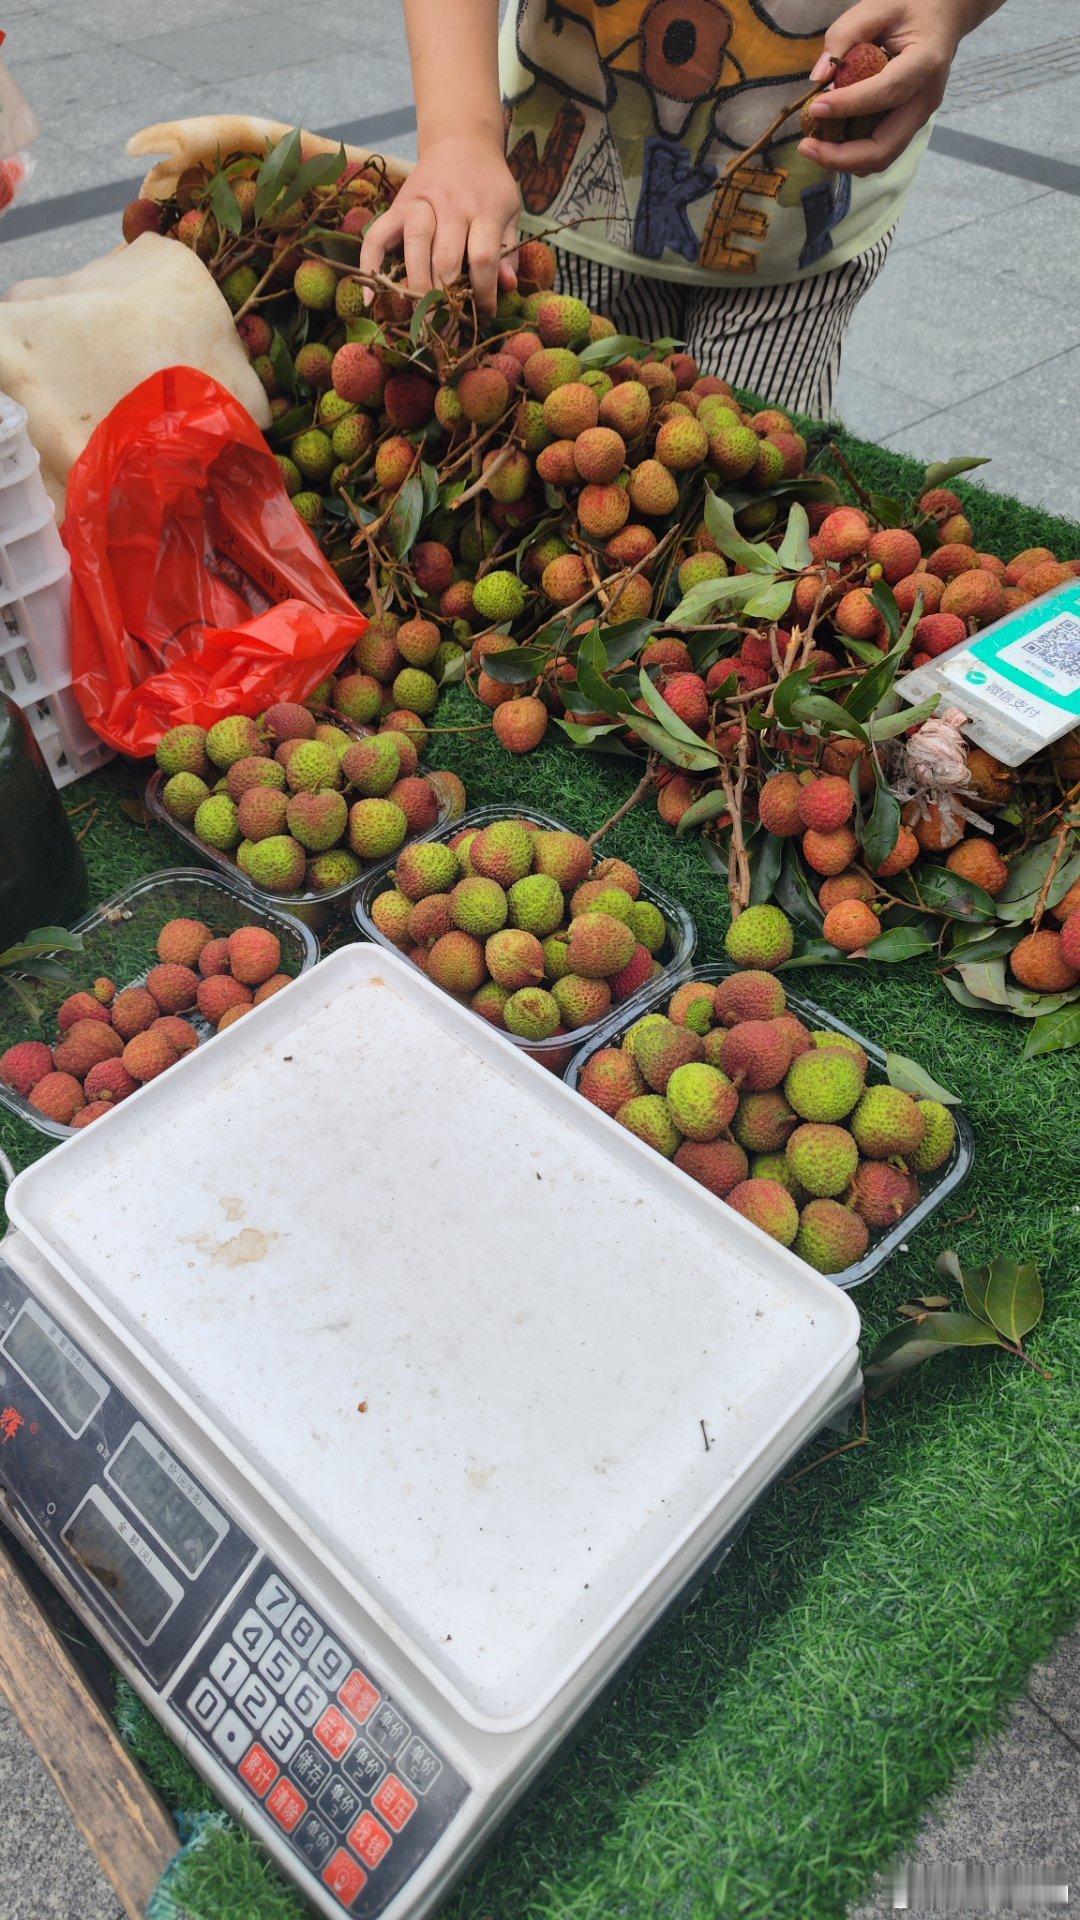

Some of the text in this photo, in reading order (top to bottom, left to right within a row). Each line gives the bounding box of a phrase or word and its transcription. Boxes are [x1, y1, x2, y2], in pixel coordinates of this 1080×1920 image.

[985, 683, 1041, 718] 微信支付
[120, 1522, 153, 1565] 金额(元)
[267, 1585, 289, 1611] 7
[243, 1627, 263, 1650] 4
[291, 1616, 315, 1647] 8
[221, 1657, 238, 1682] 1
[266, 1651, 293, 1682] 5
[317, 1648, 343, 1680] 9
[195, 1689, 218, 1720] 0
[243, 1685, 267, 1720] 2
[294, 1684, 320, 1716] 6
[269, 1718, 294, 1751] 3
[320, 1716, 348, 1752] 去皮
[380, 1710, 403, 1740] 单价
[245, 1751, 272, 1787] 累计
[297, 1750, 325, 1786] 储存
[353, 1767, 364, 1781] 2
[355, 1748, 379, 1777] 单价
[410, 1745, 435, 1776] 单价
[410, 1766, 419, 1780] 5
[272, 1786, 299, 1822] 清除
[330, 1804, 338, 1817] 3
[331, 1784, 354, 1814] 单价
[381, 1786, 411, 1822] 电压
[306, 1820, 330, 1847] 单价
